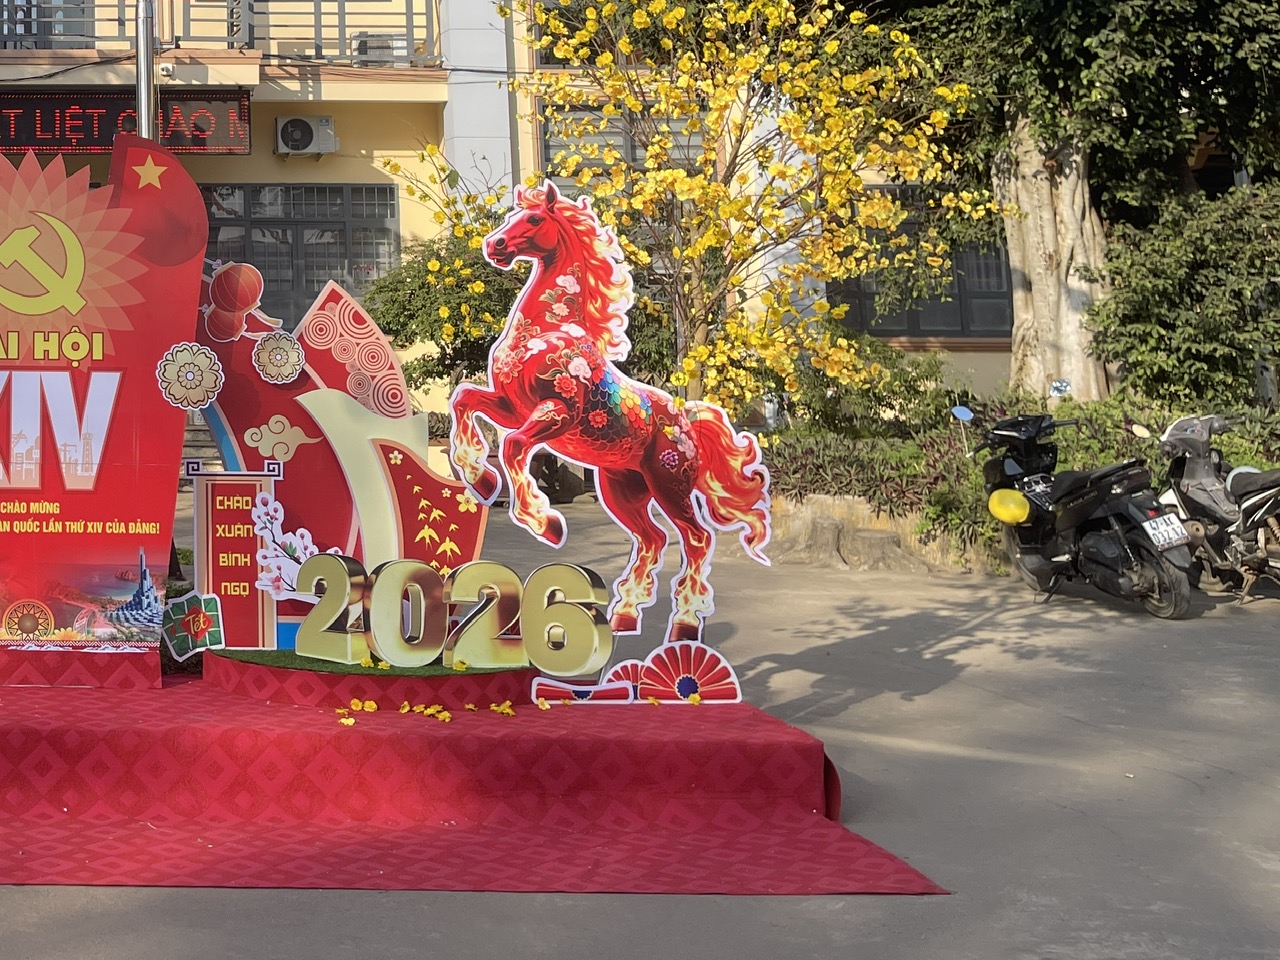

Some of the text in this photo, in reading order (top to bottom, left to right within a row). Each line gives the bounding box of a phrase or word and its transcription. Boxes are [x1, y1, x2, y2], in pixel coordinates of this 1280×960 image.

[36, 106, 106, 145] LIỆT
[33, 326, 104, 368] HỘI
[0, 499, 60, 514] CHÀO MỪNG
[215, 494, 252, 509] CHÀO
[13, 517, 40, 533] QUỐC
[65, 519, 85, 533] THỨ
[87, 521, 103, 533] XIV
[106, 518, 126, 534] CỦA
[128, 519, 160, 534] ĐẢNG!
[215, 522, 253, 538] XUÂN
[219, 550, 251, 567] BÍNH
[221, 582, 250, 598] NGỌ
[294, 552, 613, 677] 2026
[184, 613, 209, 635] Tết
